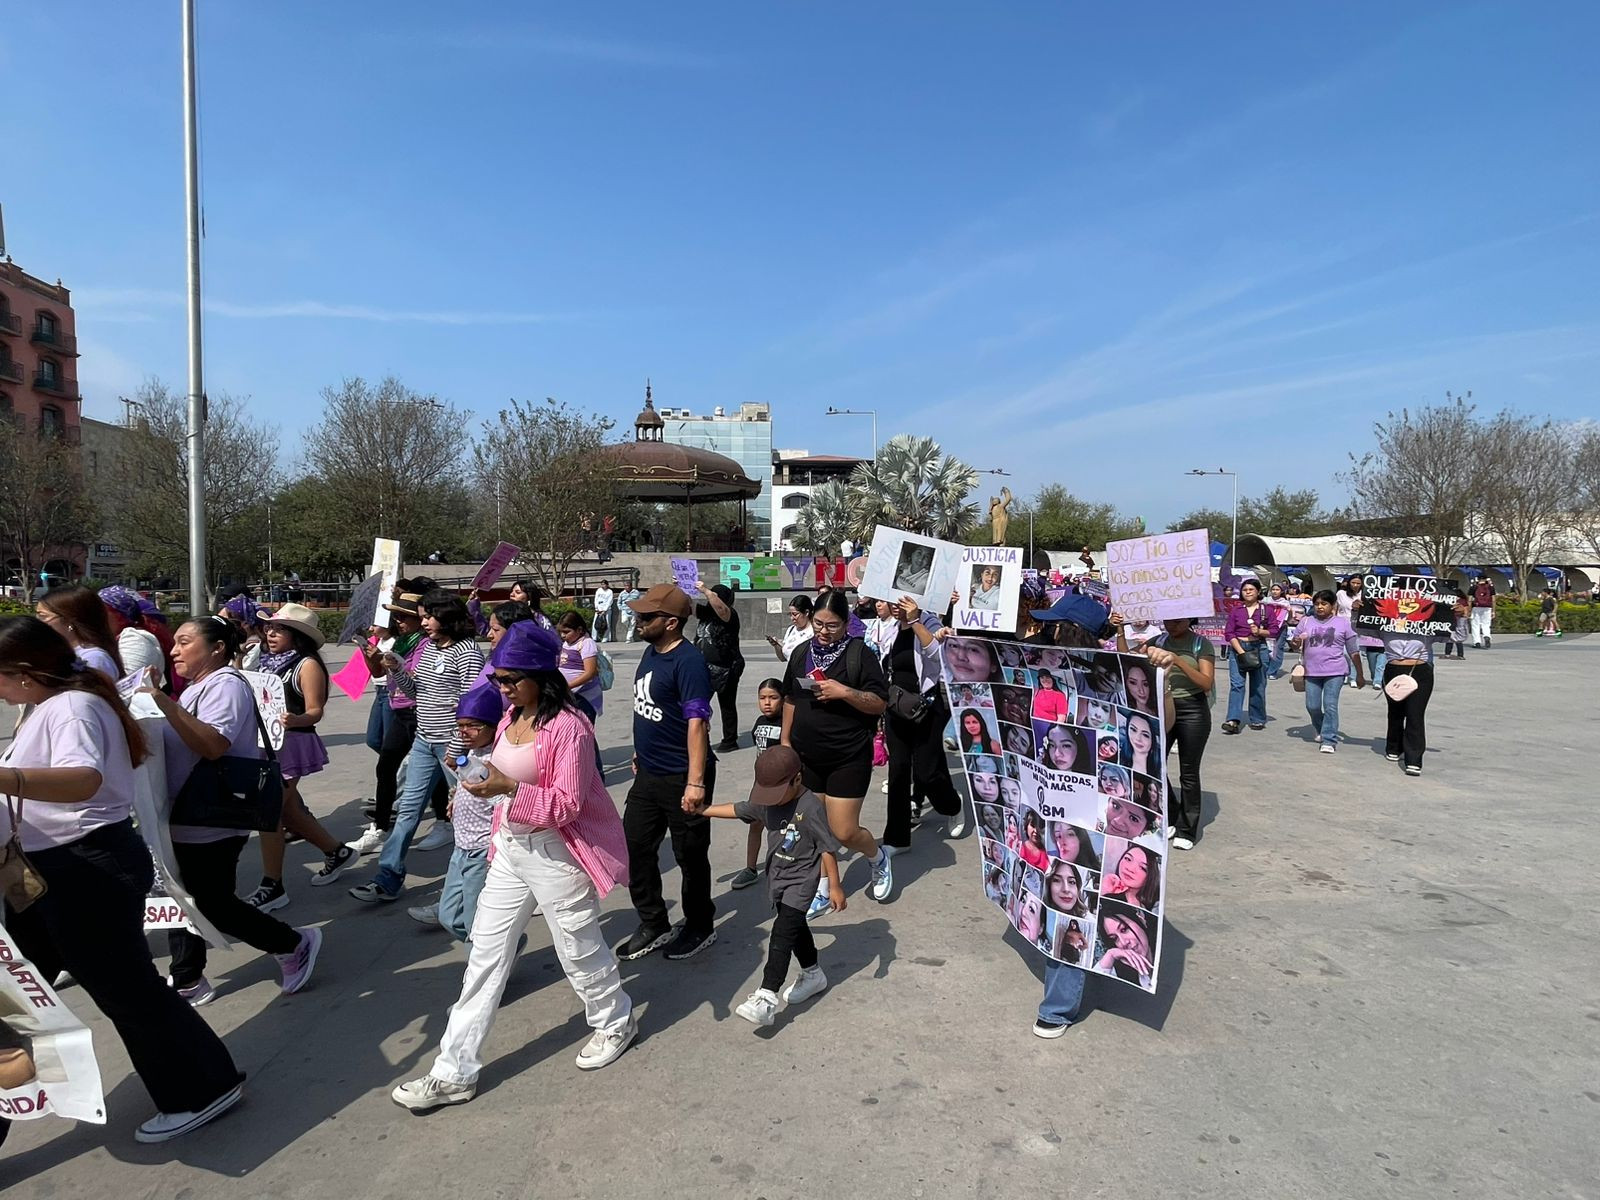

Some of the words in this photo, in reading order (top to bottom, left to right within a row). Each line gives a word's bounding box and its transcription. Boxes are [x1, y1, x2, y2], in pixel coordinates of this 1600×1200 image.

[962, 548, 1017, 563] JUSTICIA
[1110, 543, 1136, 563] SOY
[1176, 537, 1195, 553] de
[1172, 562, 1204, 584] que
[1364, 575, 1399, 591] QUE
[1405, 577, 1437, 594] LOS
[1365, 589, 1416, 600] SECRETOS
[960, 610, 1001, 629] VALE
[1359, 615, 1387, 625] DEJEN
[1404, 620, 1452, 632] ENCUBRIR
[1051, 782, 1076, 792] MÁS.
[1057, 774, 1094, 789] TODAS,
[1042, 805, 1064, 818] 8M
[143, 906, 188, 923] SAP
